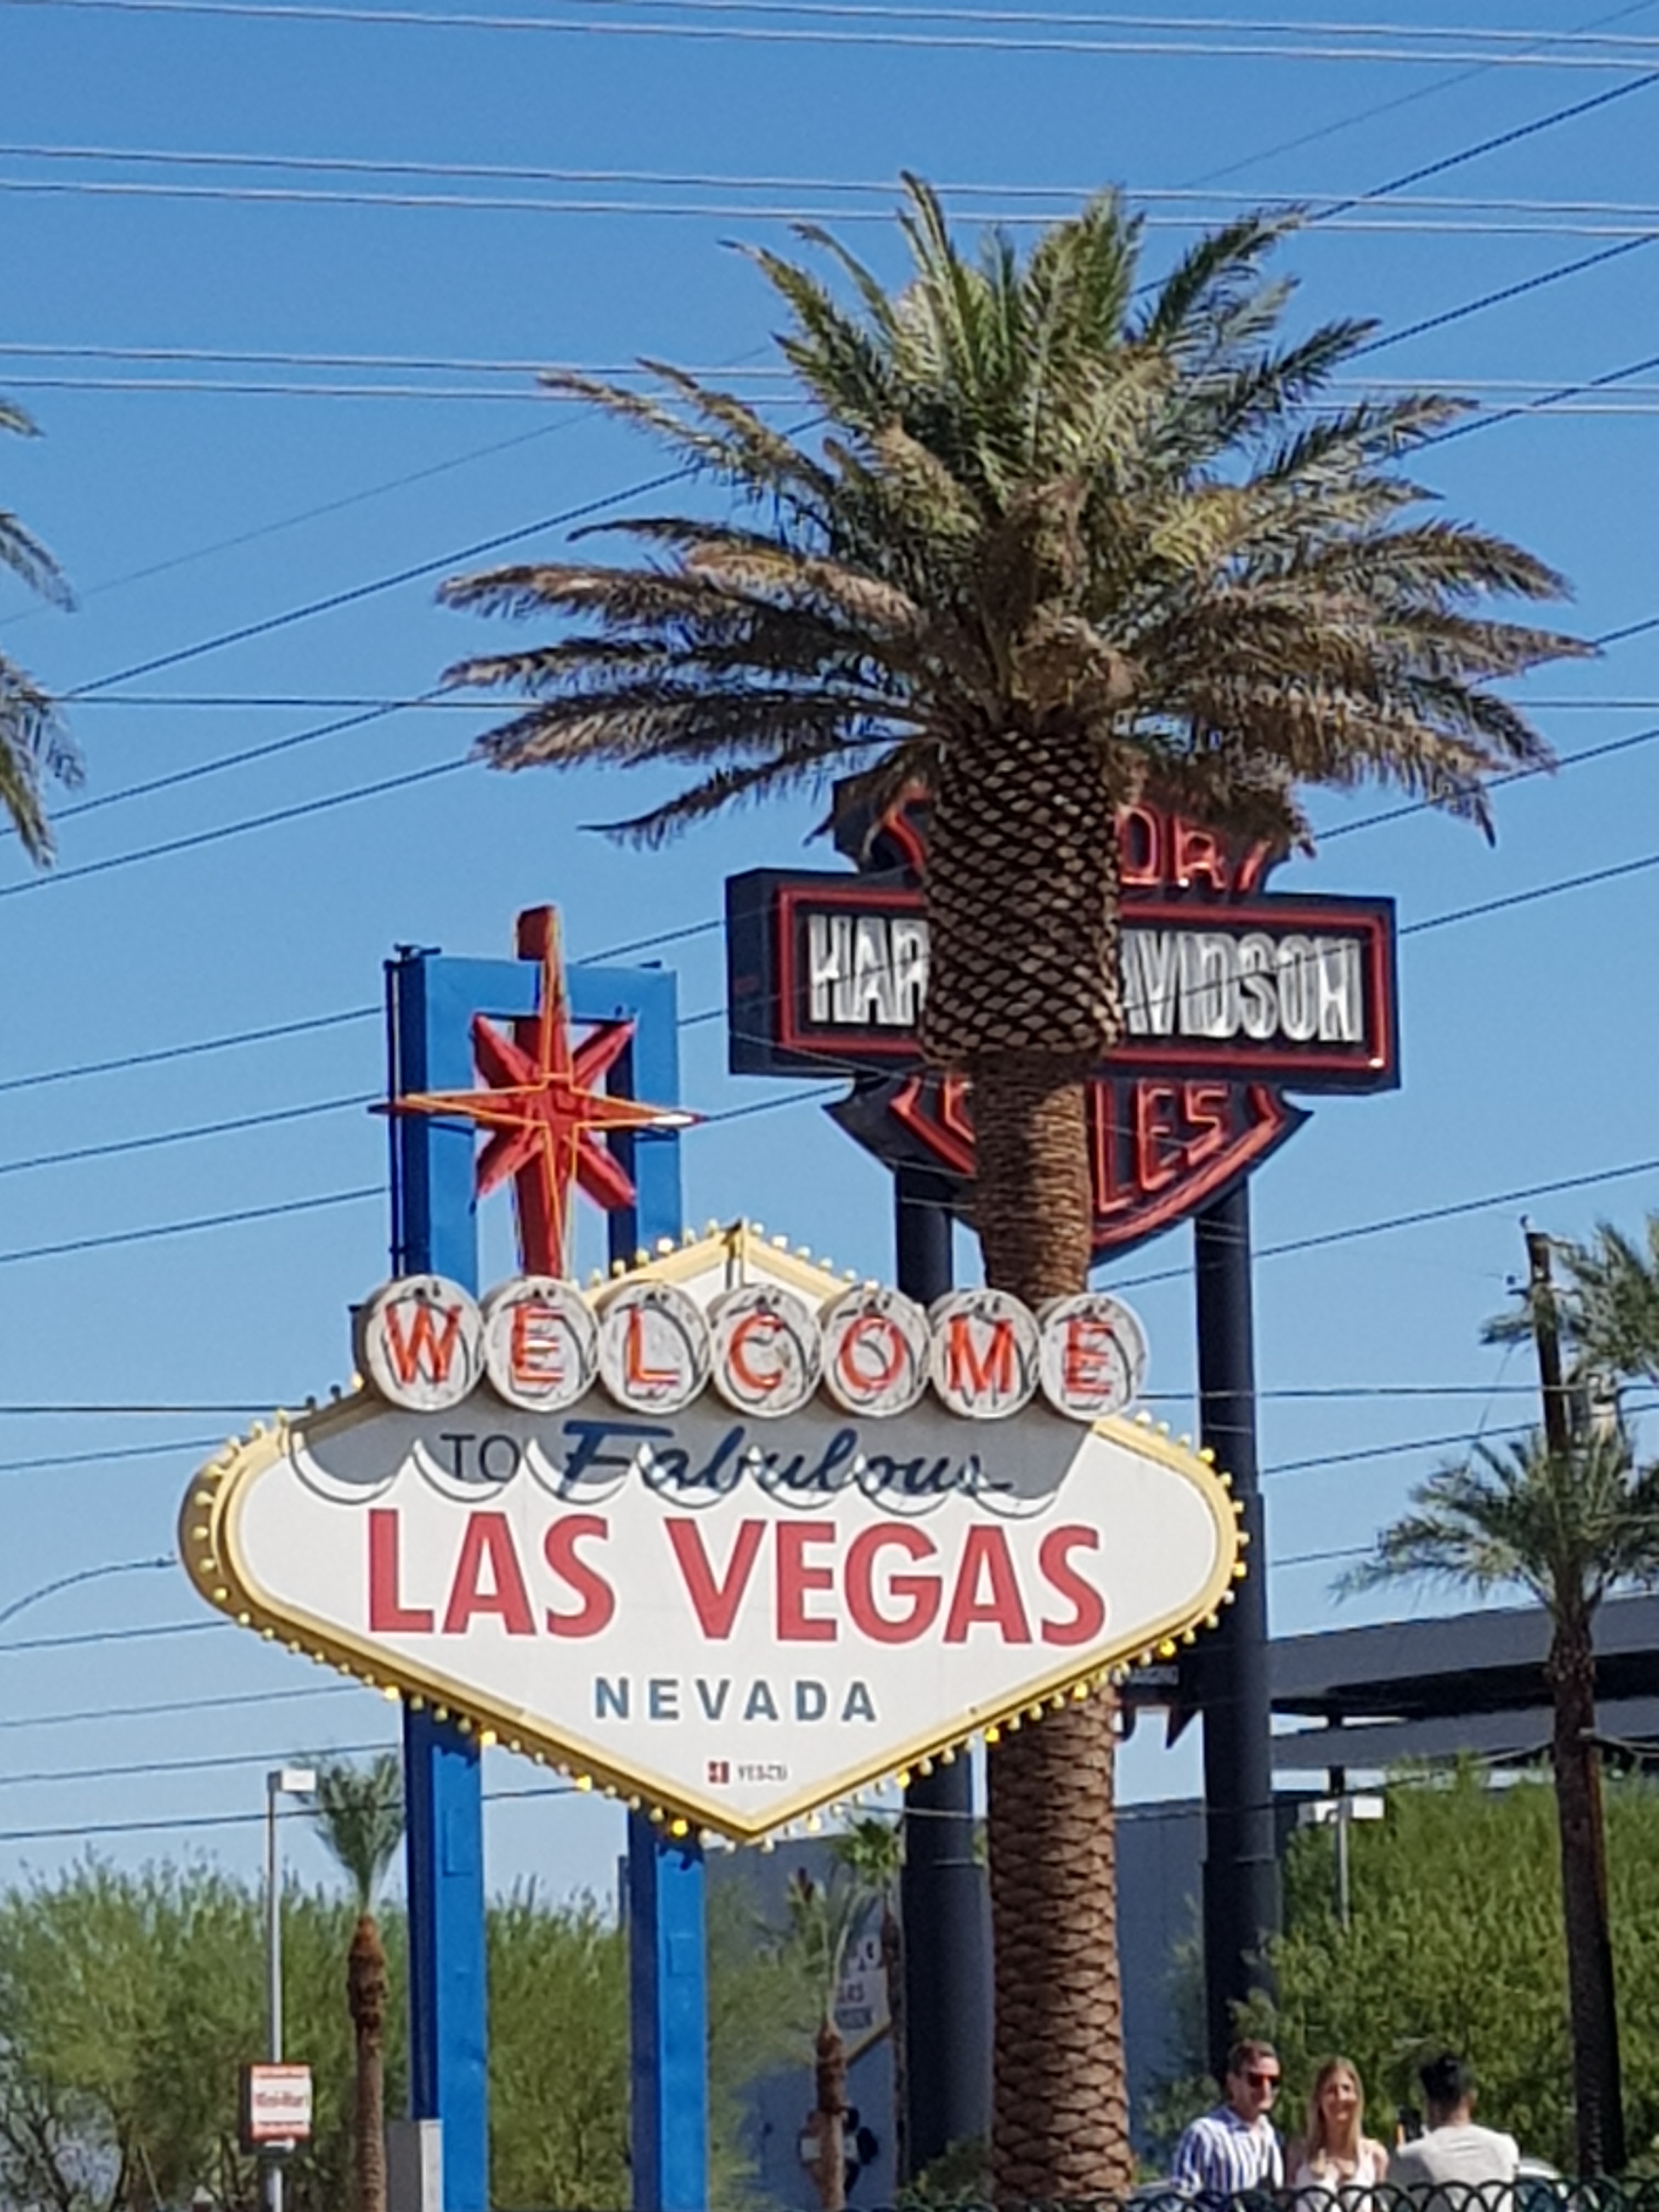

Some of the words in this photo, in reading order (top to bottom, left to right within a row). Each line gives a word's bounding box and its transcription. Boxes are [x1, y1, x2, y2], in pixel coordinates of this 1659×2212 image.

[385, 1301, 1111, 1397] WELCOME
[439, 1432, 520, 1482] TO
[558, 1418, 1013, 1499] Fabulous
[368, 1508, 617, 1639] LAS
[664, 1517, 1107, 1646] VEGAS
[594, 1676, 878, 1723] NEVADA
